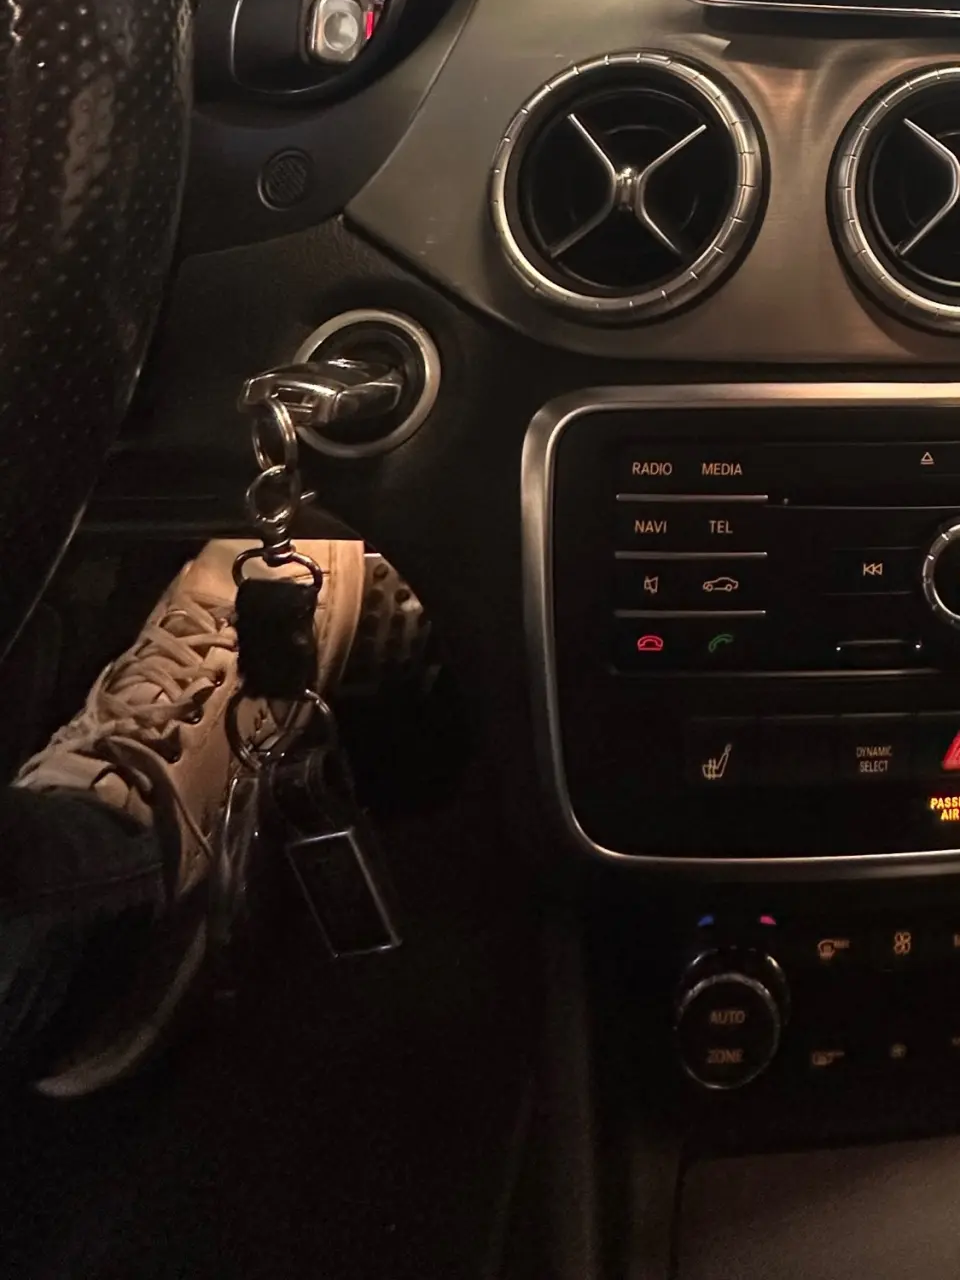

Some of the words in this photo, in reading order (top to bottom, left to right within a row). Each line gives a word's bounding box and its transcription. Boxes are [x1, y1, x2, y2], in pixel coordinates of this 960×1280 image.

[632, 462, 673, 476] RADIO
[701, 463, 743, 476] MEDIA
[635, 520, 667, 533] NAVI
[709, 520, 733, 534] TEL
[856, 745, 892, 758] DYNAMIC
[859, 760, 889, 773] SELECT
[941, 808, 960, 820] AIR
[709, 1009, 746, 1025] AUTO
